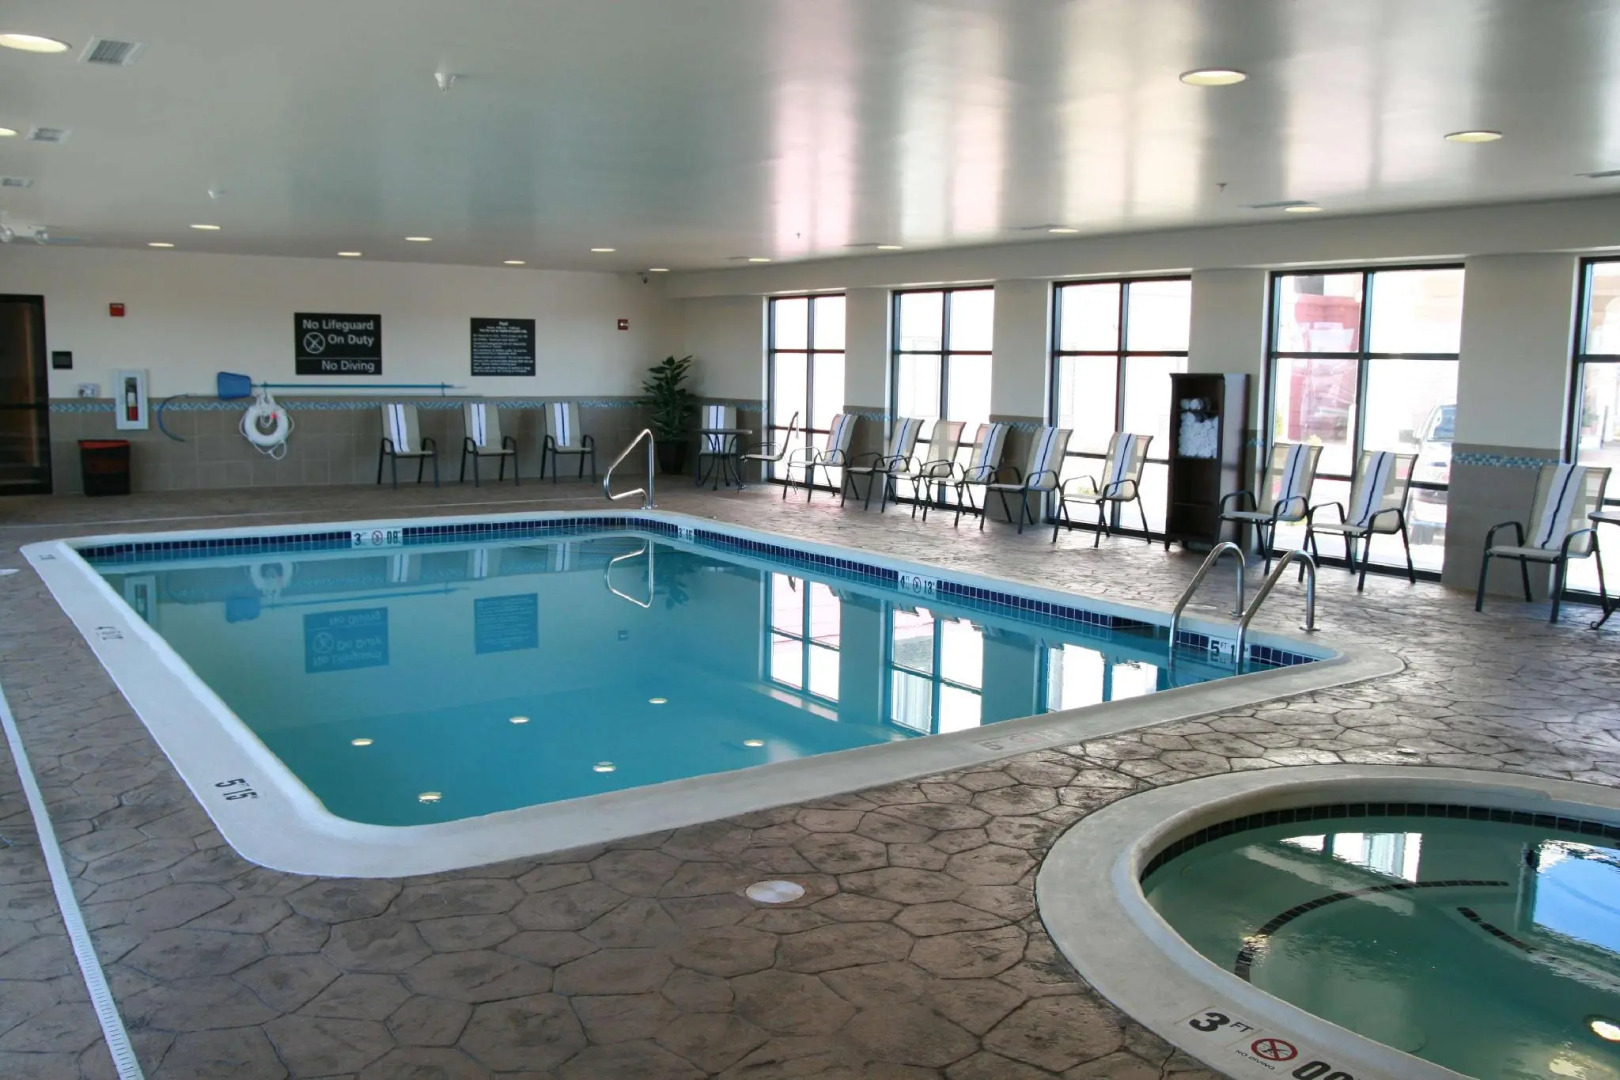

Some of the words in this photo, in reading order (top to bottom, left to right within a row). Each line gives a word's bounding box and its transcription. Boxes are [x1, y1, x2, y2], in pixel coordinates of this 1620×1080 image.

[303, 319, 319, 329] No
[322, 319, 374, 332] Lifeguard
[328, 334, 345, 344] On
[348, 334, 374, 347] Duty
[322, 360, 338, 370] No
[341, 360, 375, 373] Diving
[1211, 640, 1220, 657] 5
[1189, 1012, 1230, 1032] 3
[1230, 1021, 1254, 1033] FT
[1235, 1049, 1248, 1057] NO
[1248, 1055, 1275, 1070] DIVING
